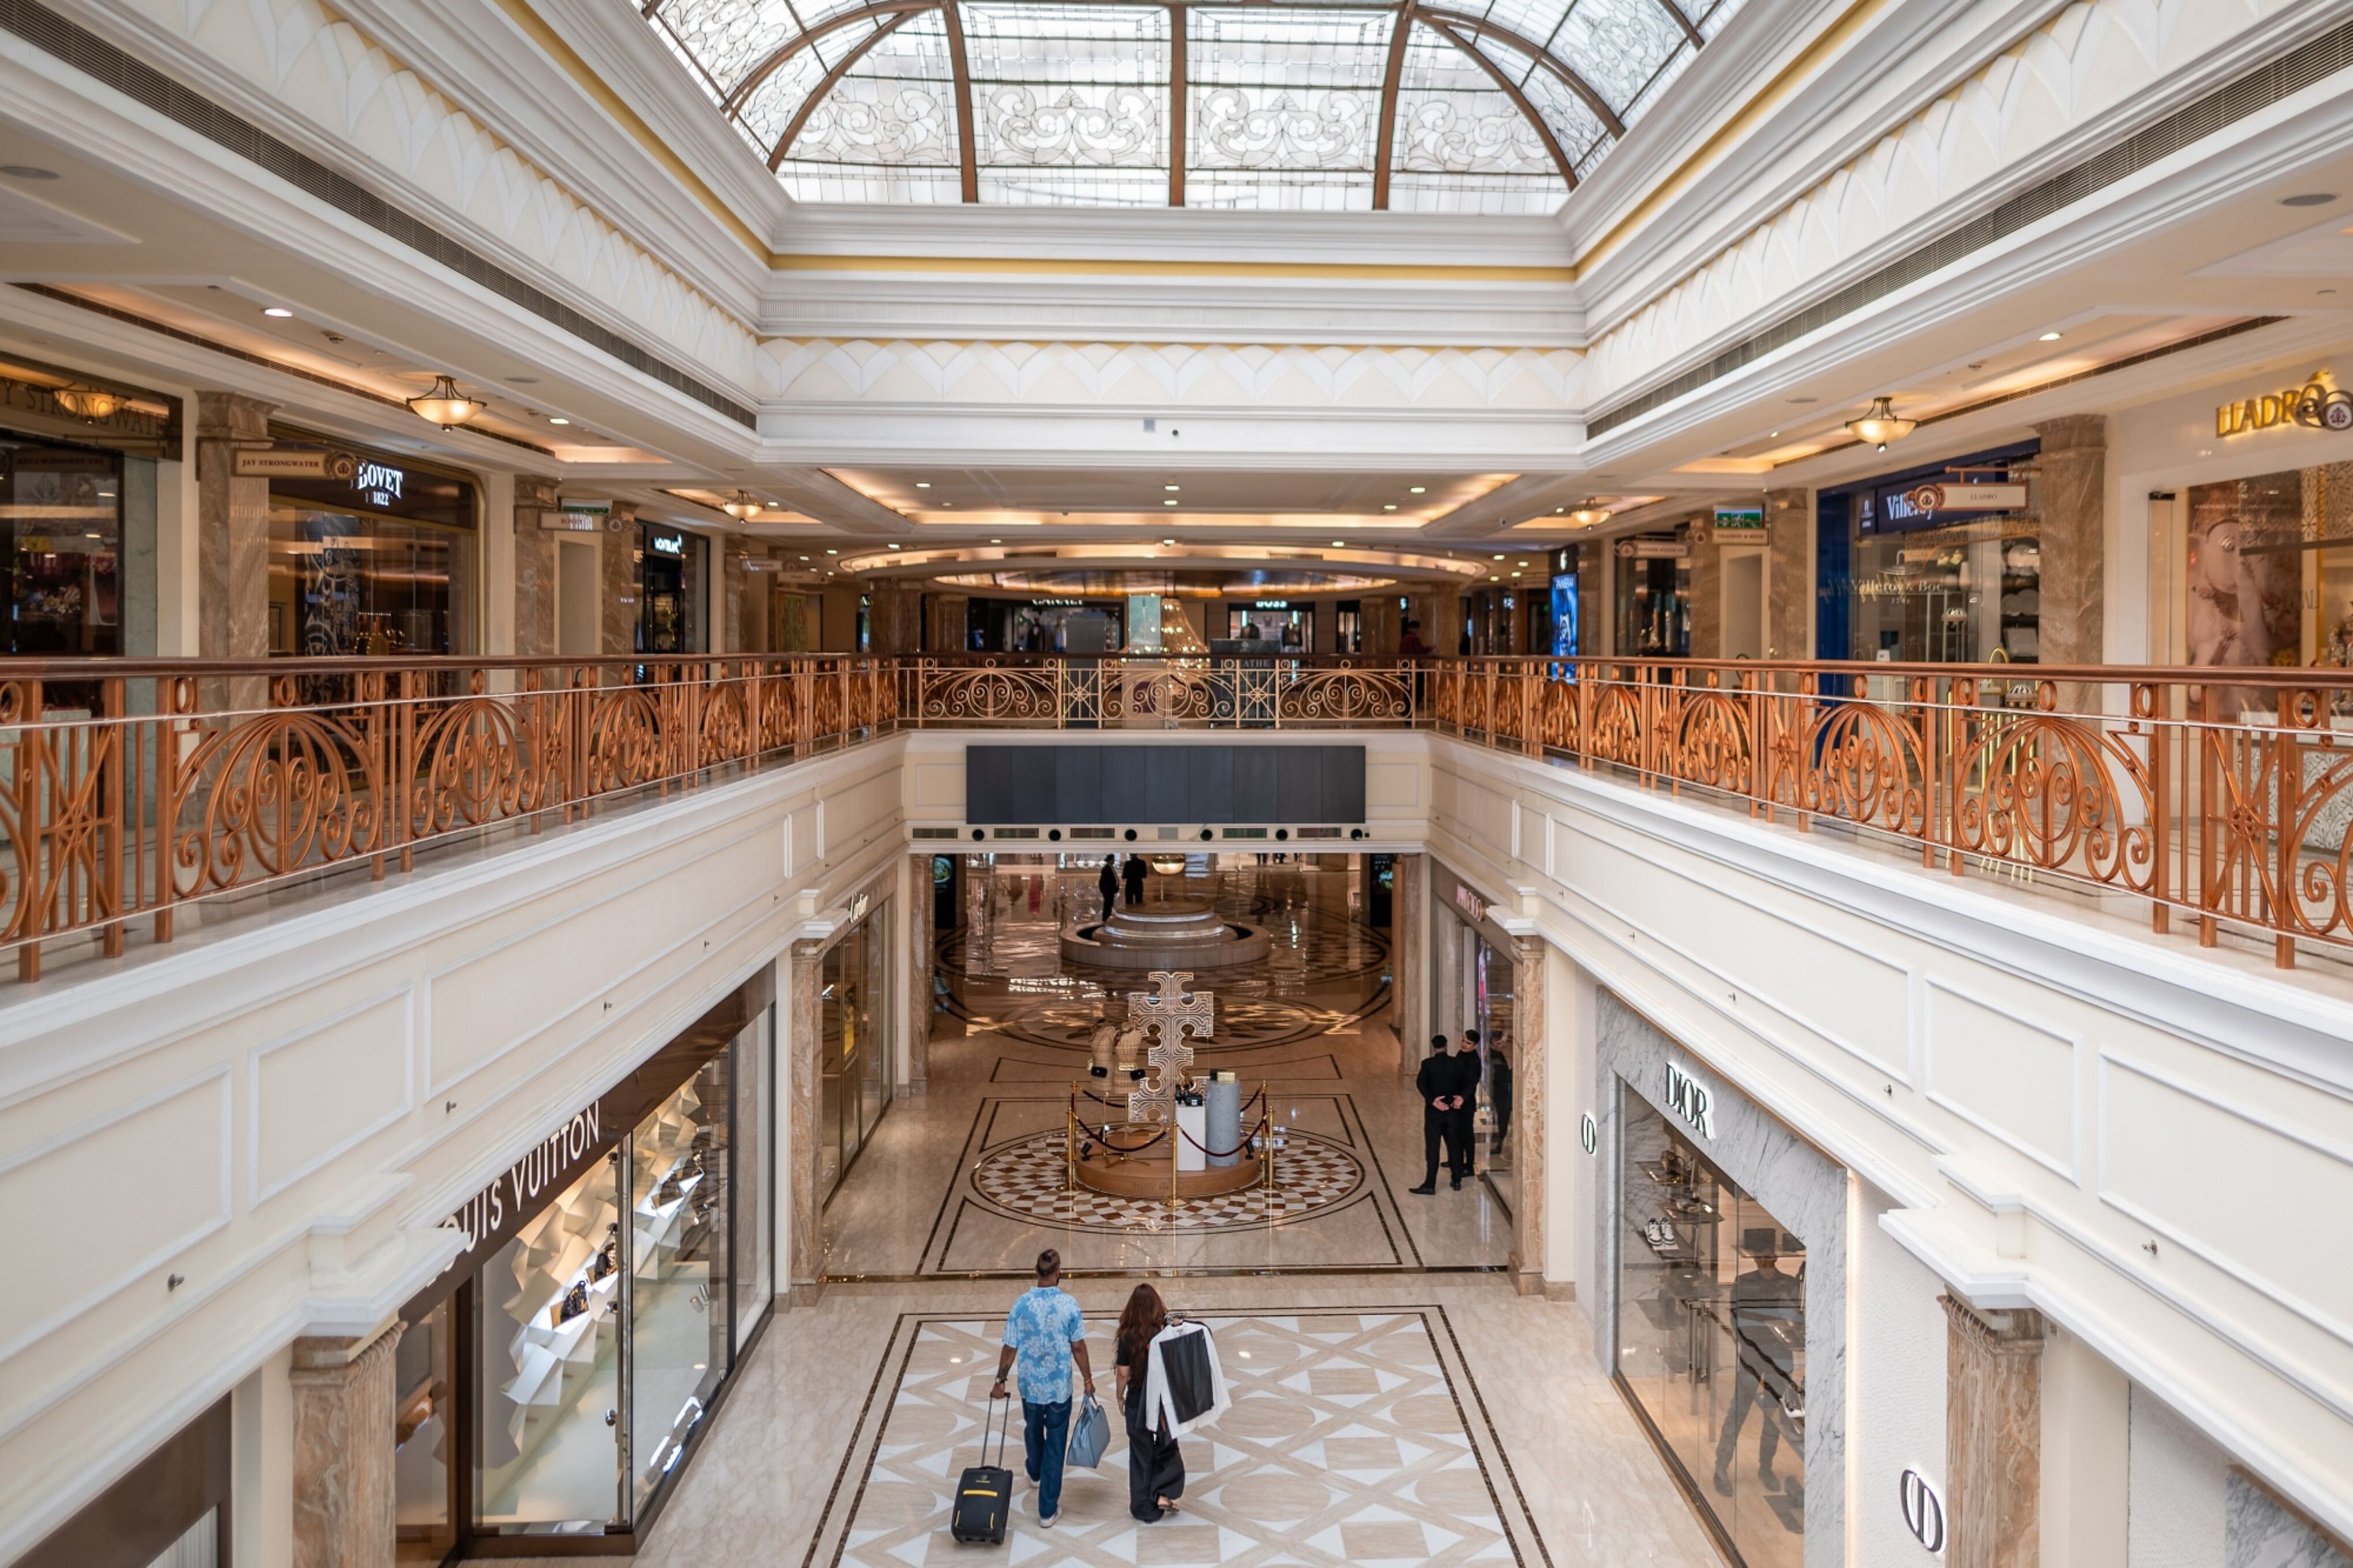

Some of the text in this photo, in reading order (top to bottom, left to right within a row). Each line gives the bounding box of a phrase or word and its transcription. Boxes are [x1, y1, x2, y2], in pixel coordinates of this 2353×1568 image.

[242, 459, 319, 468] JAY STRONGWATER
[357, 462, 403, 499] BOVET
[373, 491, 389, 506] 1822
[850, 892, 868, 923] Cartier
[1666, 1062, 1709, 1139] DIOR
[511, 1099, 599, 1212] VUITTON
